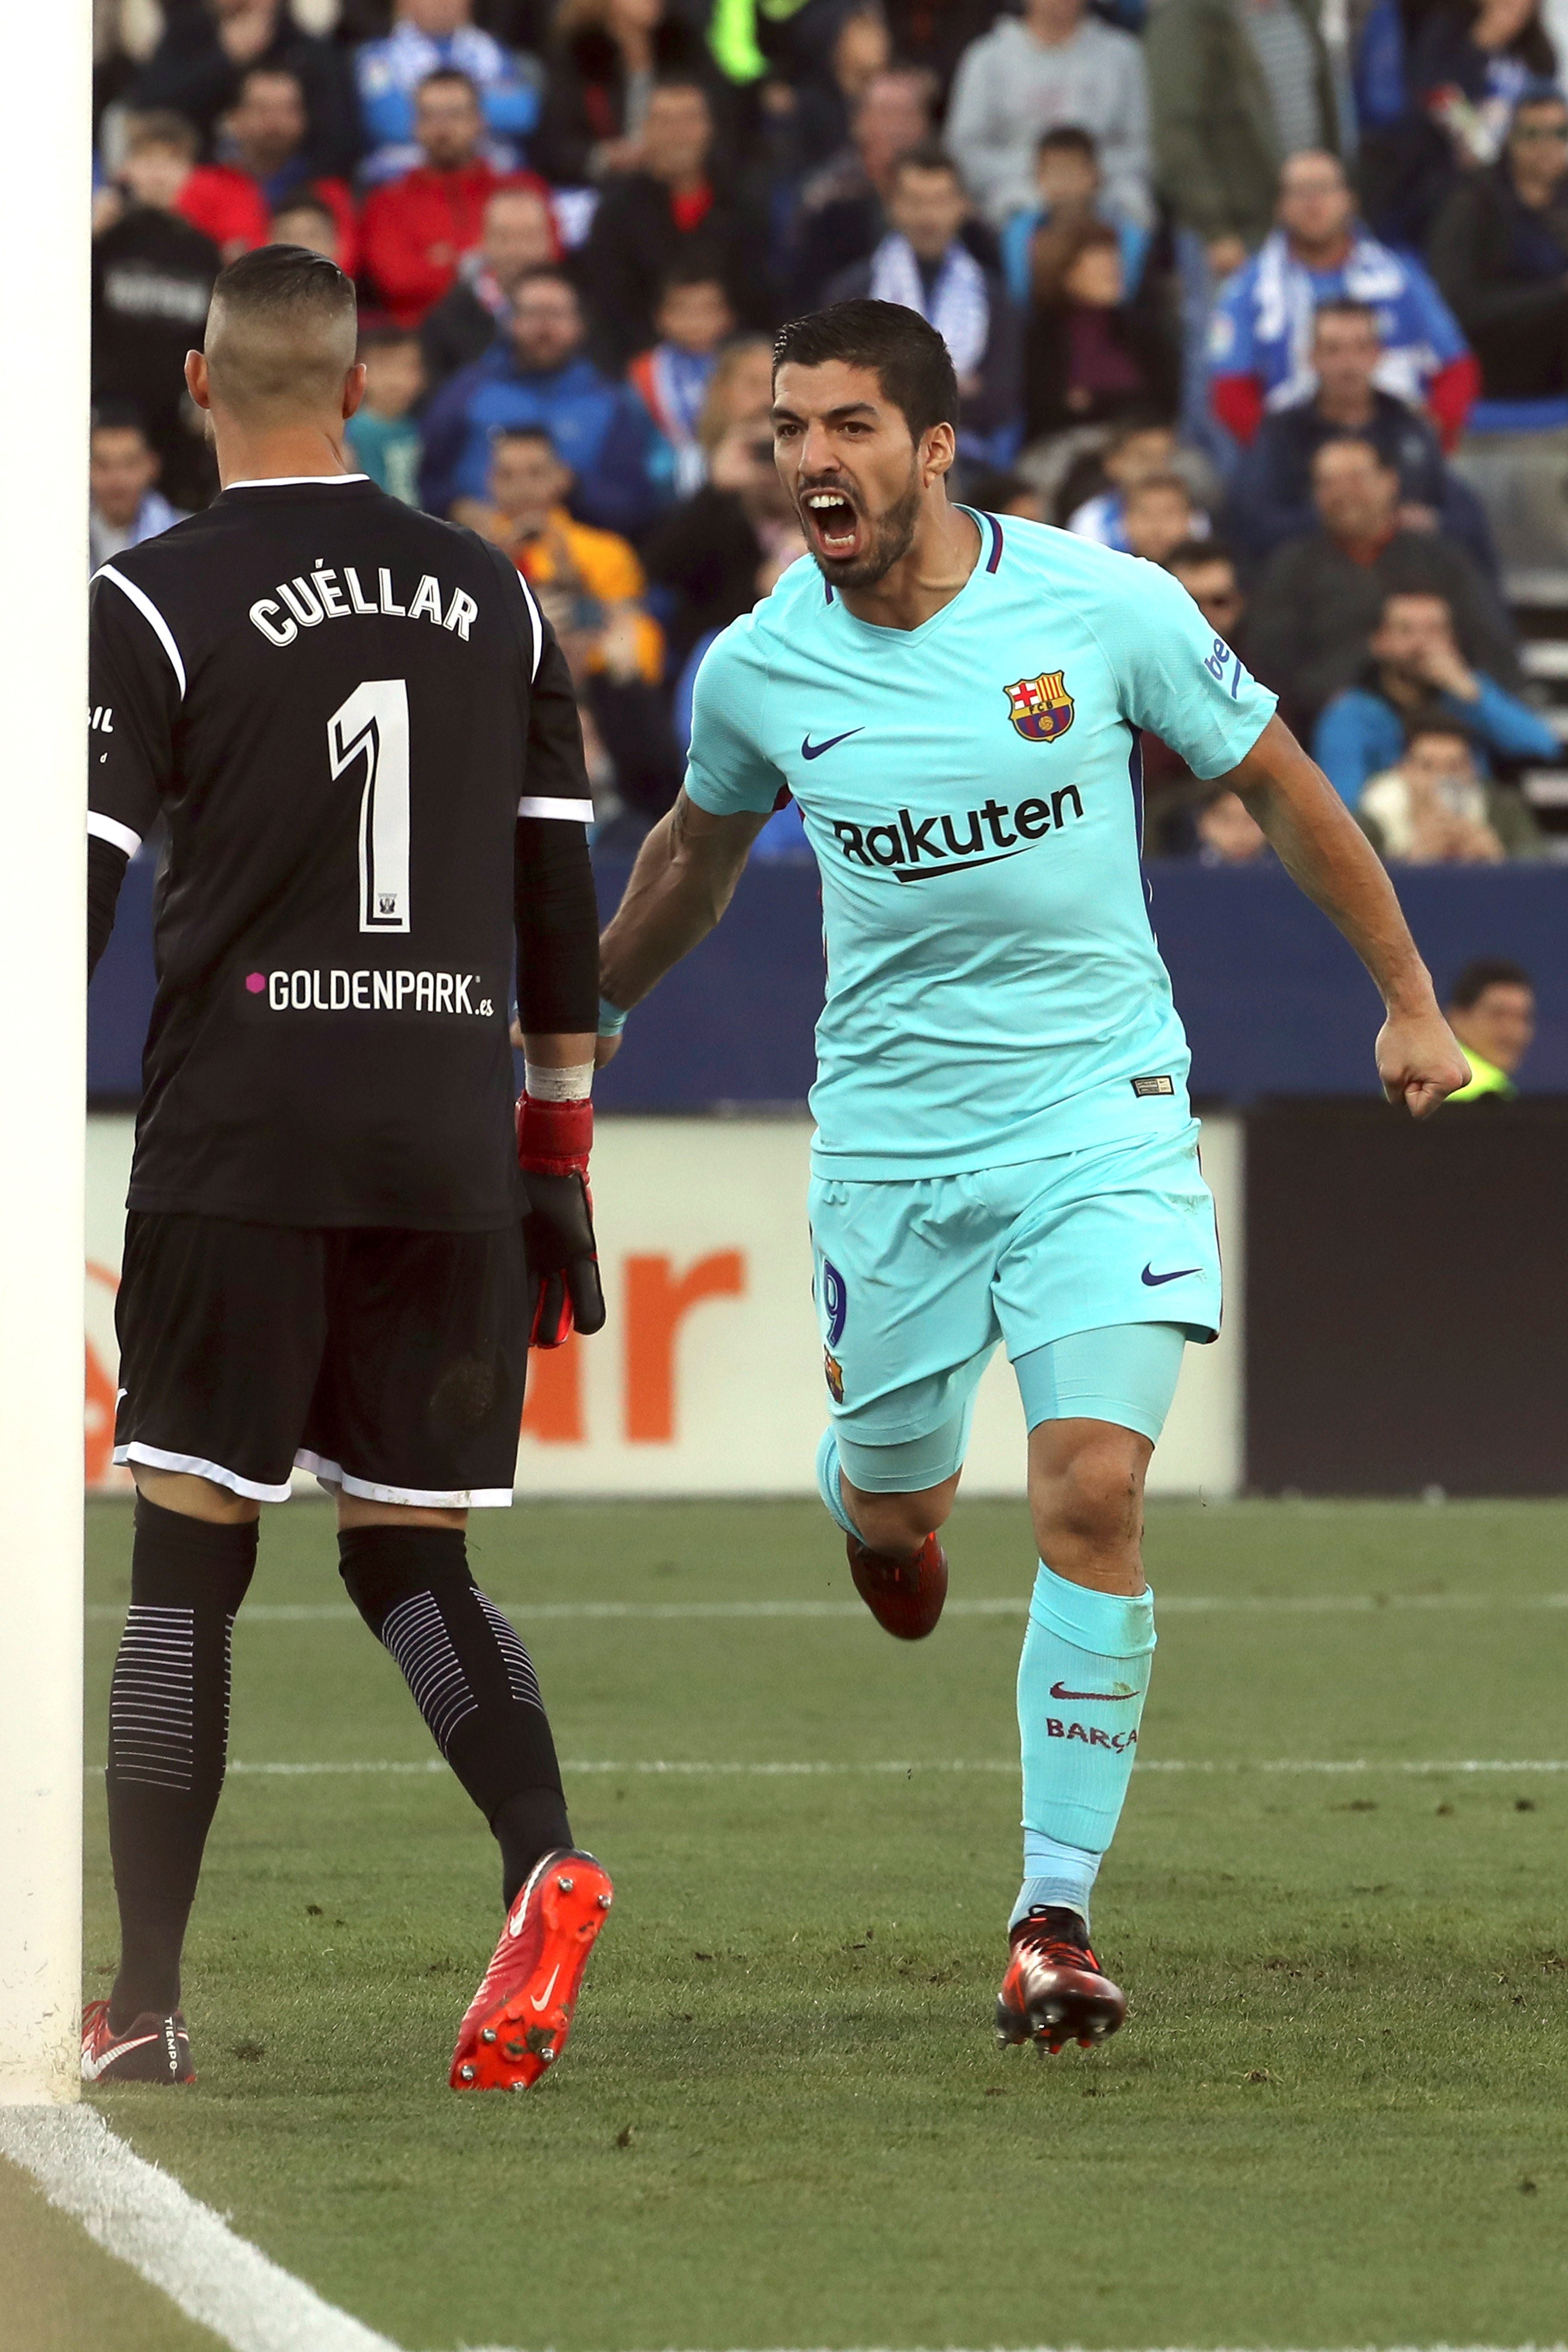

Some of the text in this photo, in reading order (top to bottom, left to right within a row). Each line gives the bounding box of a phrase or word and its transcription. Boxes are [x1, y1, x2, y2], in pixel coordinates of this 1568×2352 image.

[249, 558, 478, 646] CUÉLLAR
[327, 678, 411, 933] 1
[834, 784, 1084, 867] Rakuten
[824, 1259, 847, 1348] 9
[1046, 1718, 1137, 1754] BARÇA
